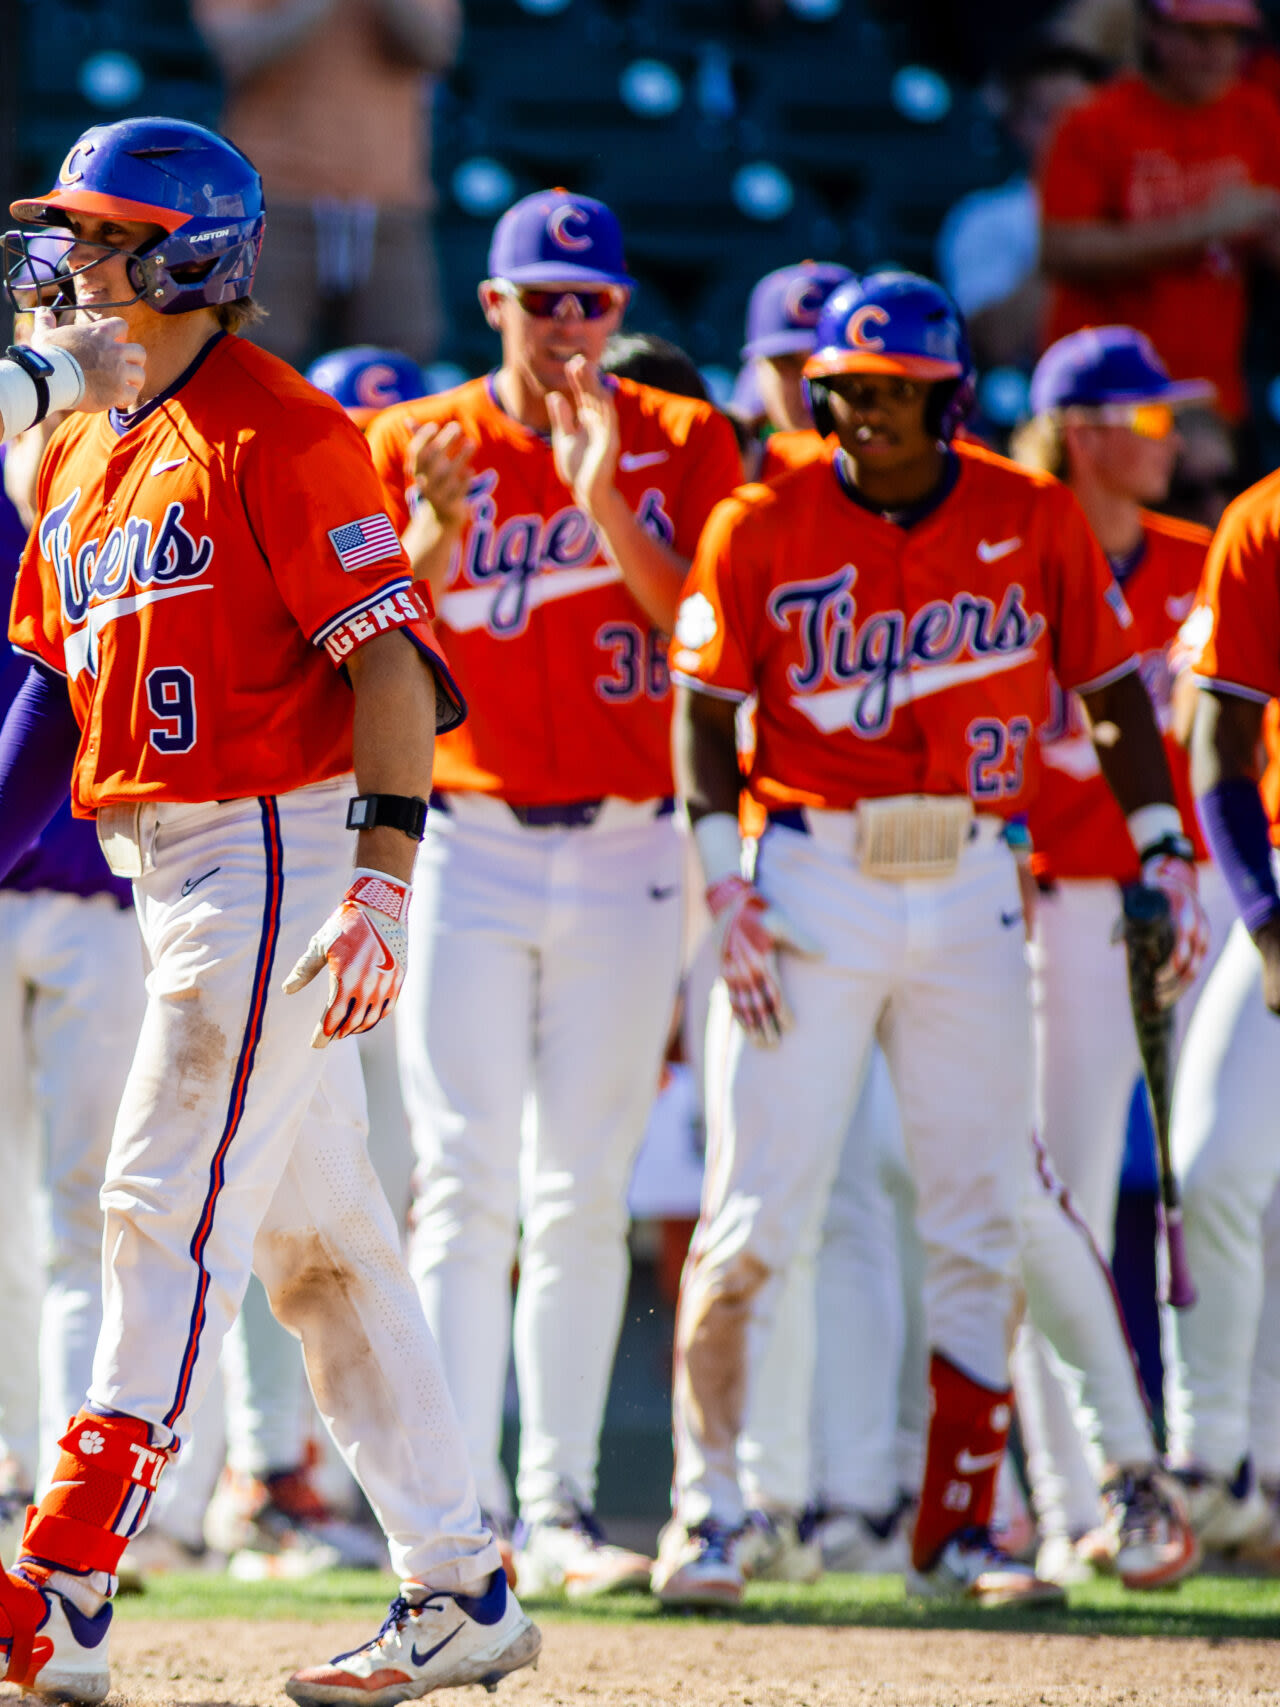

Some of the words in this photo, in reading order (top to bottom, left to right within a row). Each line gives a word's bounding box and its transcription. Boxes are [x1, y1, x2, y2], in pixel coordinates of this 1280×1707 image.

[59, 140, 96, 185] C
[189, 229, 230, 243] EASTON
[546, 204, 594, 252] C
[846, 304, 890, 352] C
[356, 364, 402, 408] C
[767, 563, 1046, 740] Tigers
[145, 666, 197, 754] 9
